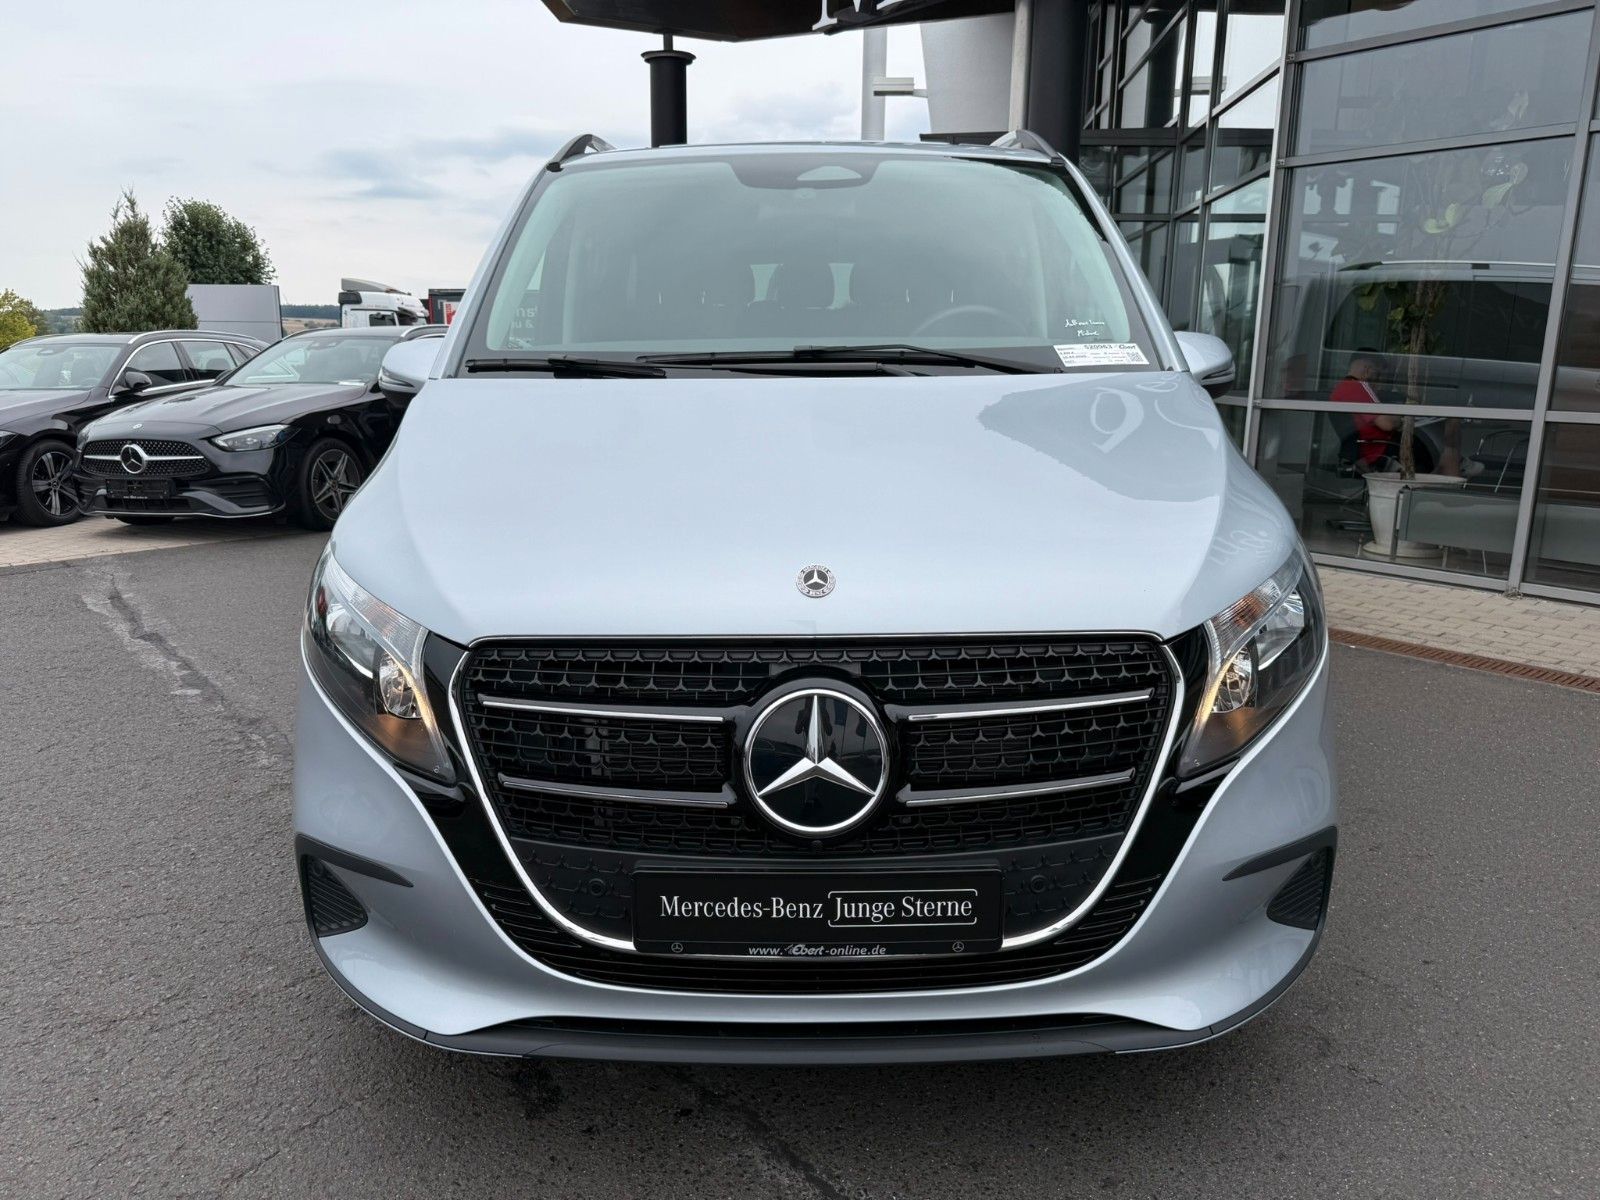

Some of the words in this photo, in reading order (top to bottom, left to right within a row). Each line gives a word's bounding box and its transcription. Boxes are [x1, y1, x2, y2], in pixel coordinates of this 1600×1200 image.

[659, 895, 824, 919] Mercedes-Benz
[833, 897, 895, 923] Junge
[901, 896, 972, 918] Sterne
[748, 944, 887, 956] www.Ebert-online.de
